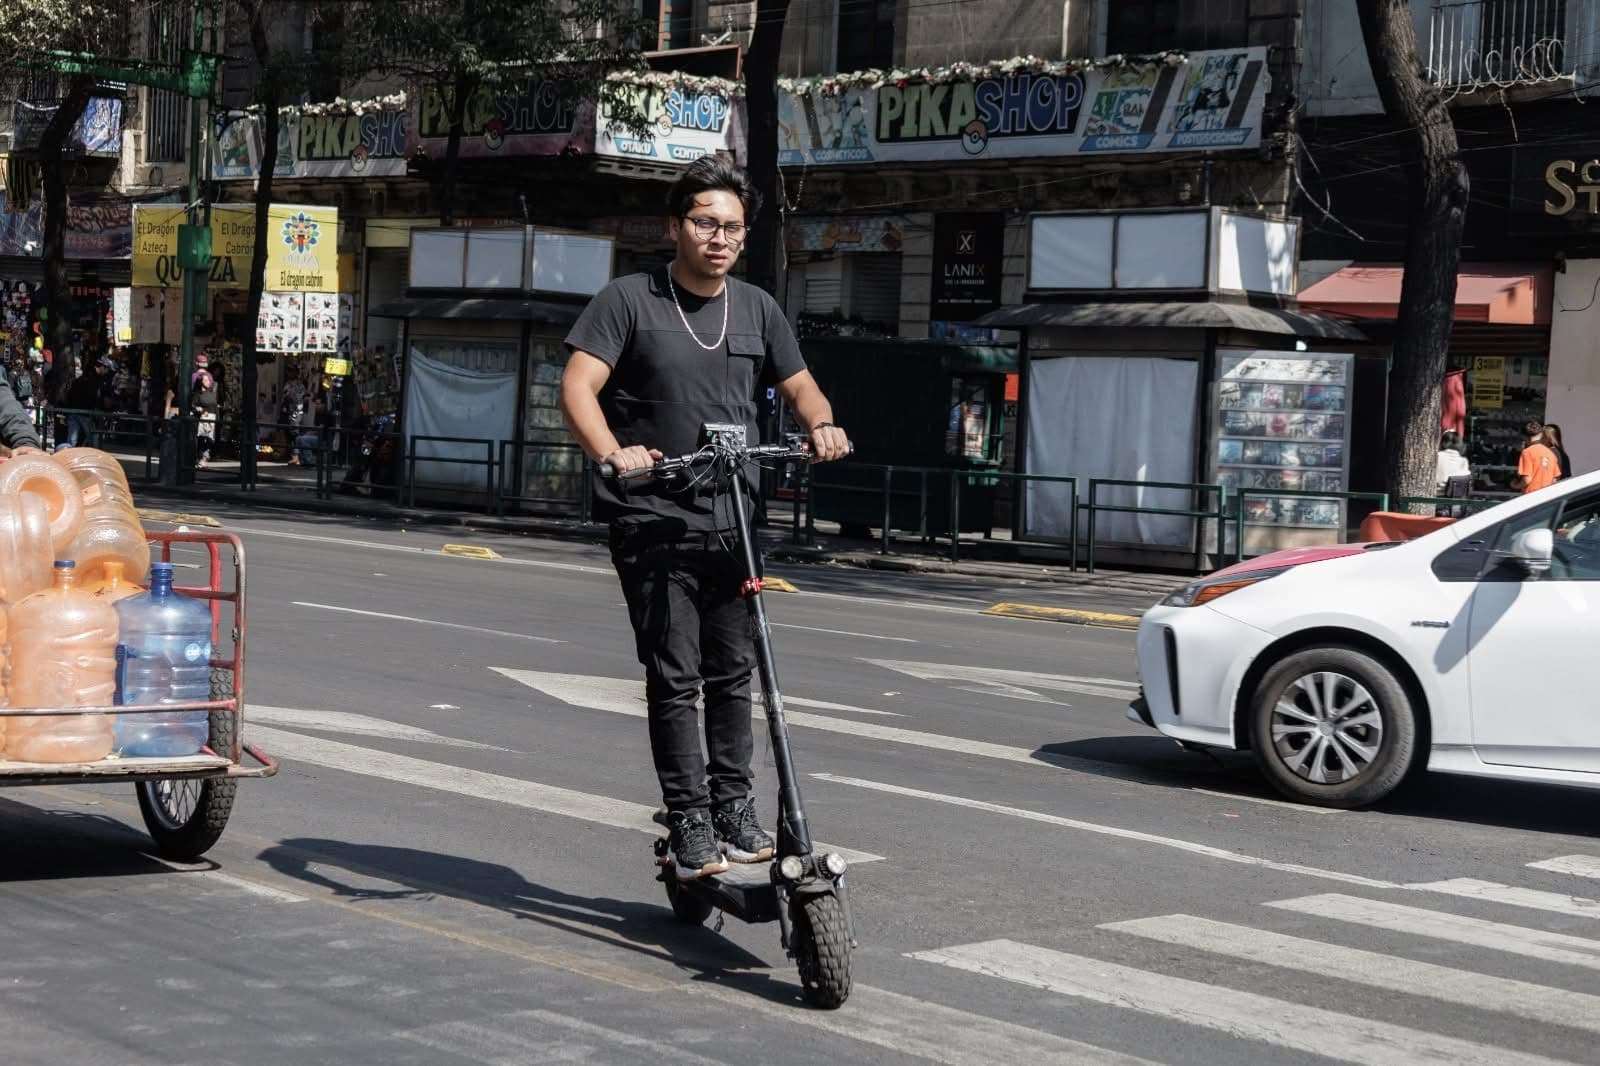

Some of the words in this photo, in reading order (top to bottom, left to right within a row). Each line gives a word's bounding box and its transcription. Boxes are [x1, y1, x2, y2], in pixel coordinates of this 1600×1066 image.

[621, 142, 652, 154] OTAKU
[1096, 136, 1137, 148] COMICS
[221, 222, 229, 235] El
[142, 241, 168, 253] Azteca
[944, 264, 984, 276] LANIX
[280, 270, 286, 286] El
